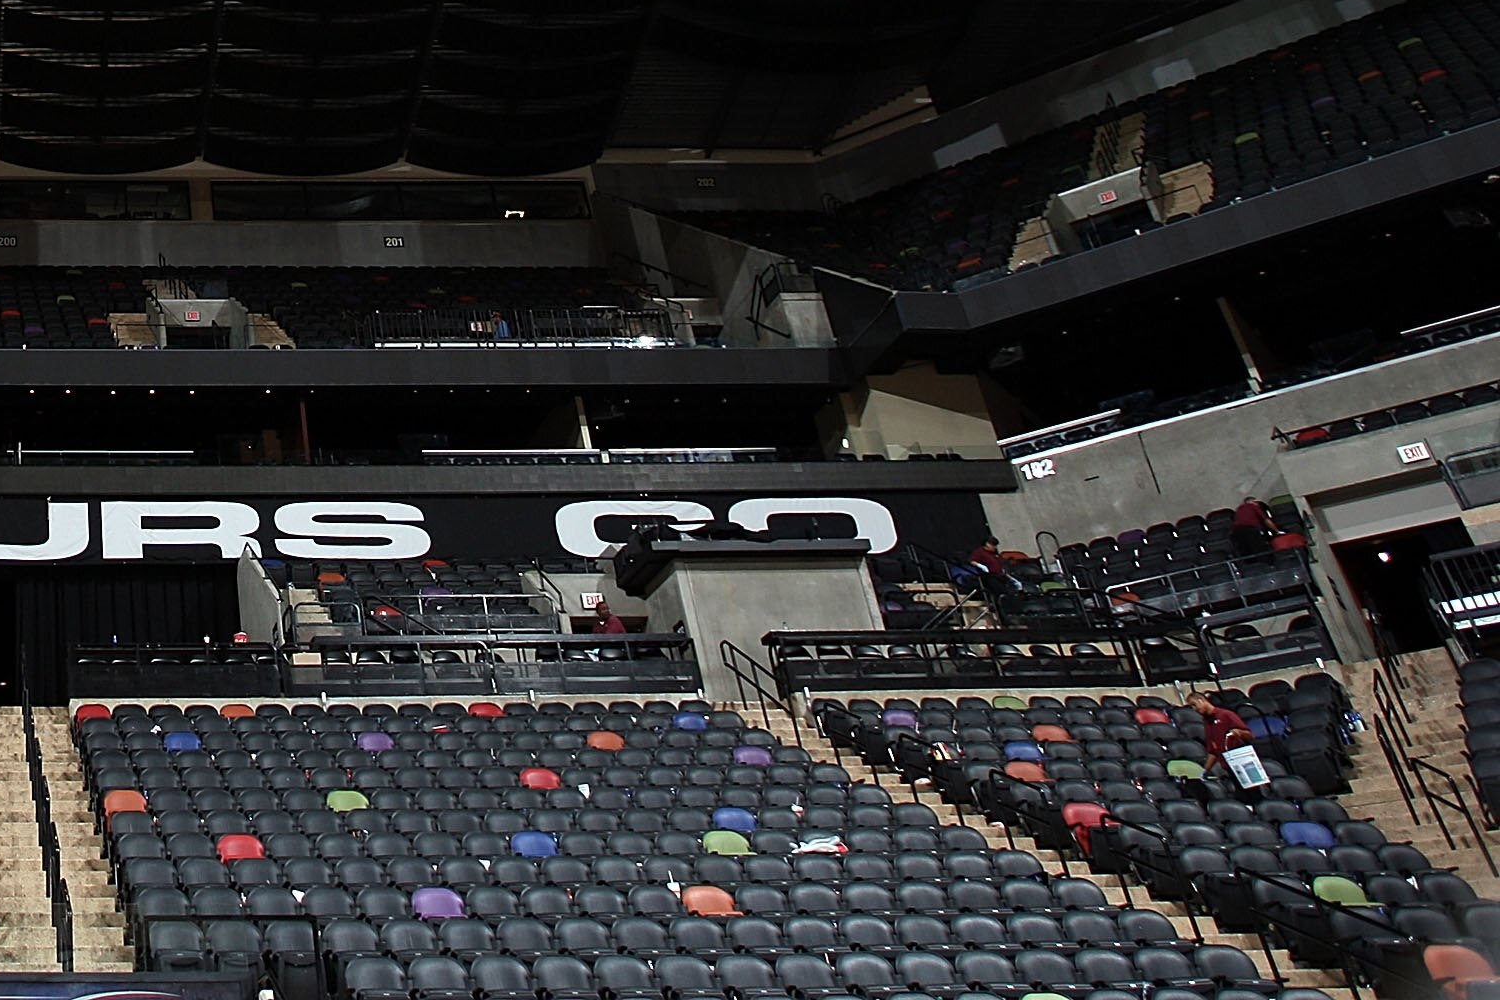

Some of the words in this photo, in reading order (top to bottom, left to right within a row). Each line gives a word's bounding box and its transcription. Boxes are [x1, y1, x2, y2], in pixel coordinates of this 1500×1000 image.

[697, 178, 715, 187] 202
[385, 237, 404, 247] 201
[1403, 445, 1425, 459] EXIT
